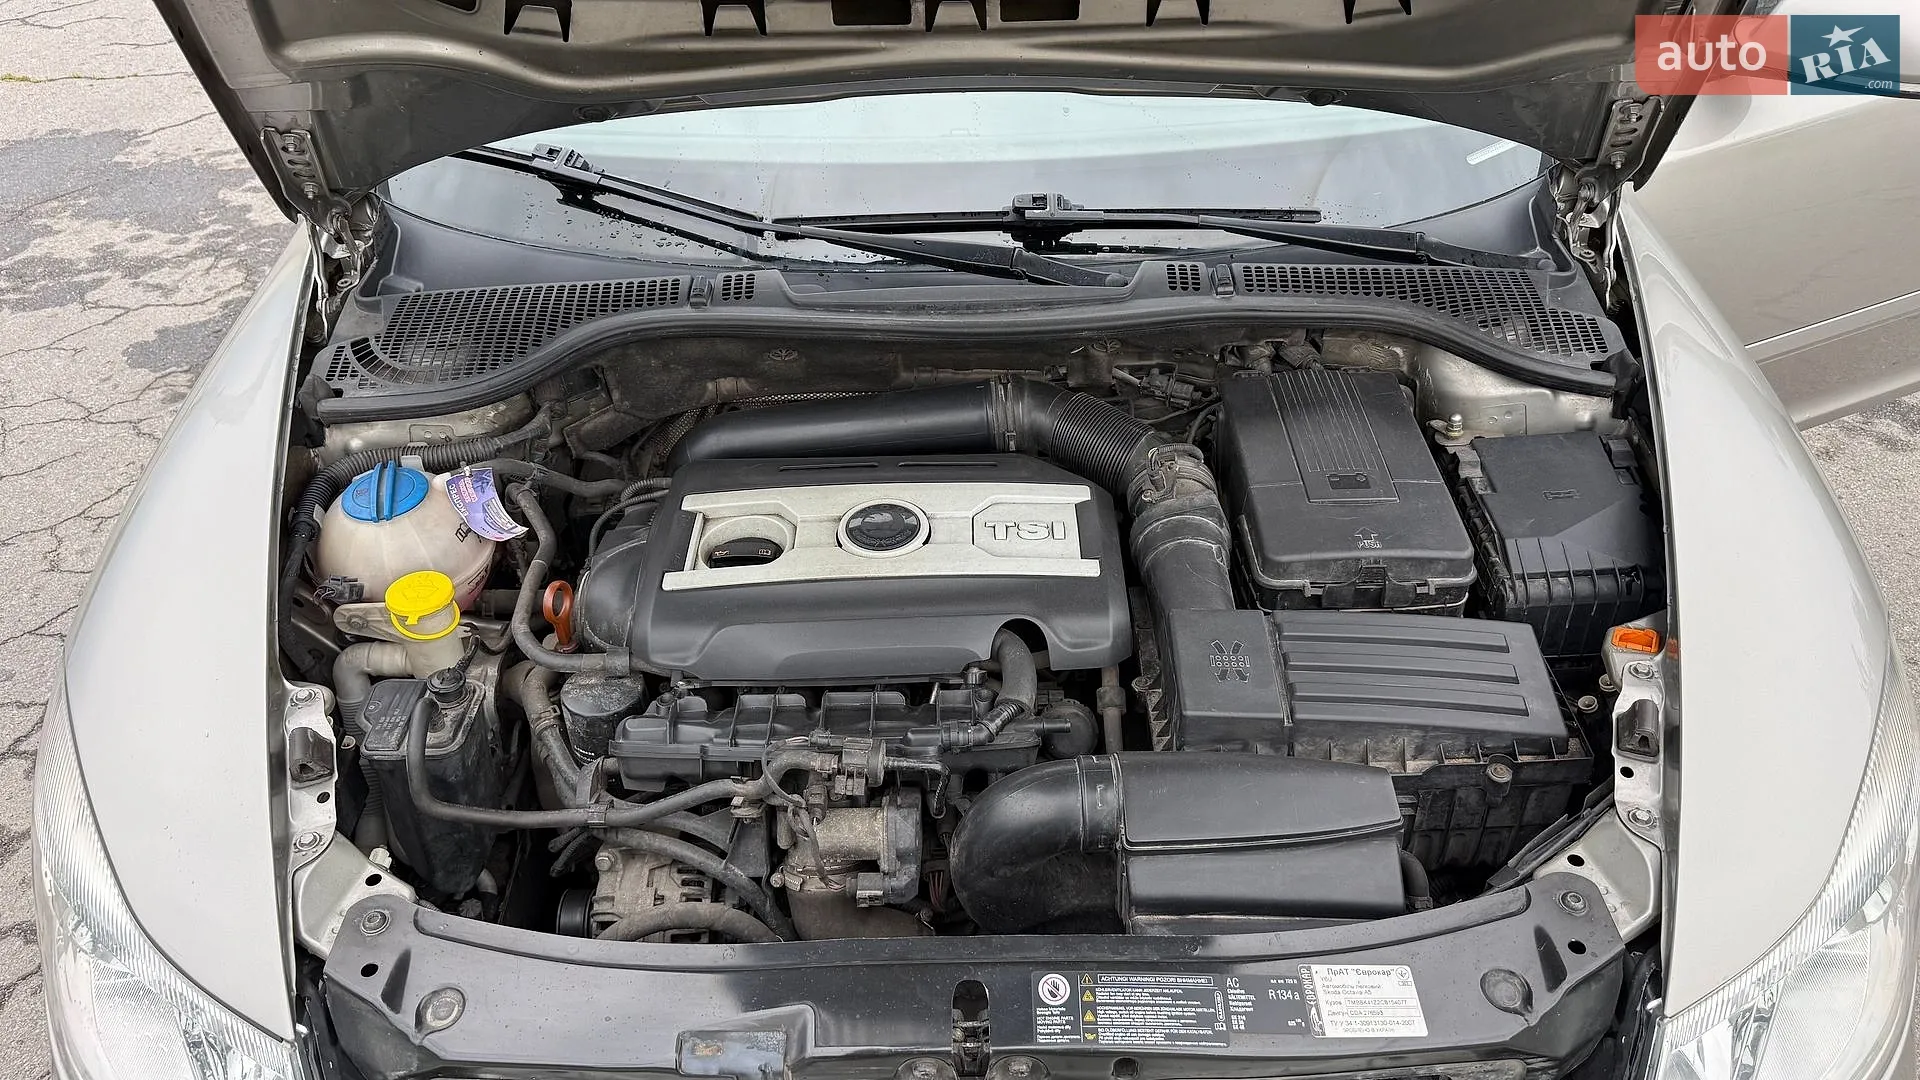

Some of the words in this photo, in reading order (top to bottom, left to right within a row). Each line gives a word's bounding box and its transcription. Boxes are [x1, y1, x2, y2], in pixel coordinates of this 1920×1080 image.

[985, 520, 1068, 541] TSI
[1357, 539, 1382, 549] PUSH
[1327, 968, 1350, 977] ПрАТ
[1226, 977, 1239, 988] AC
